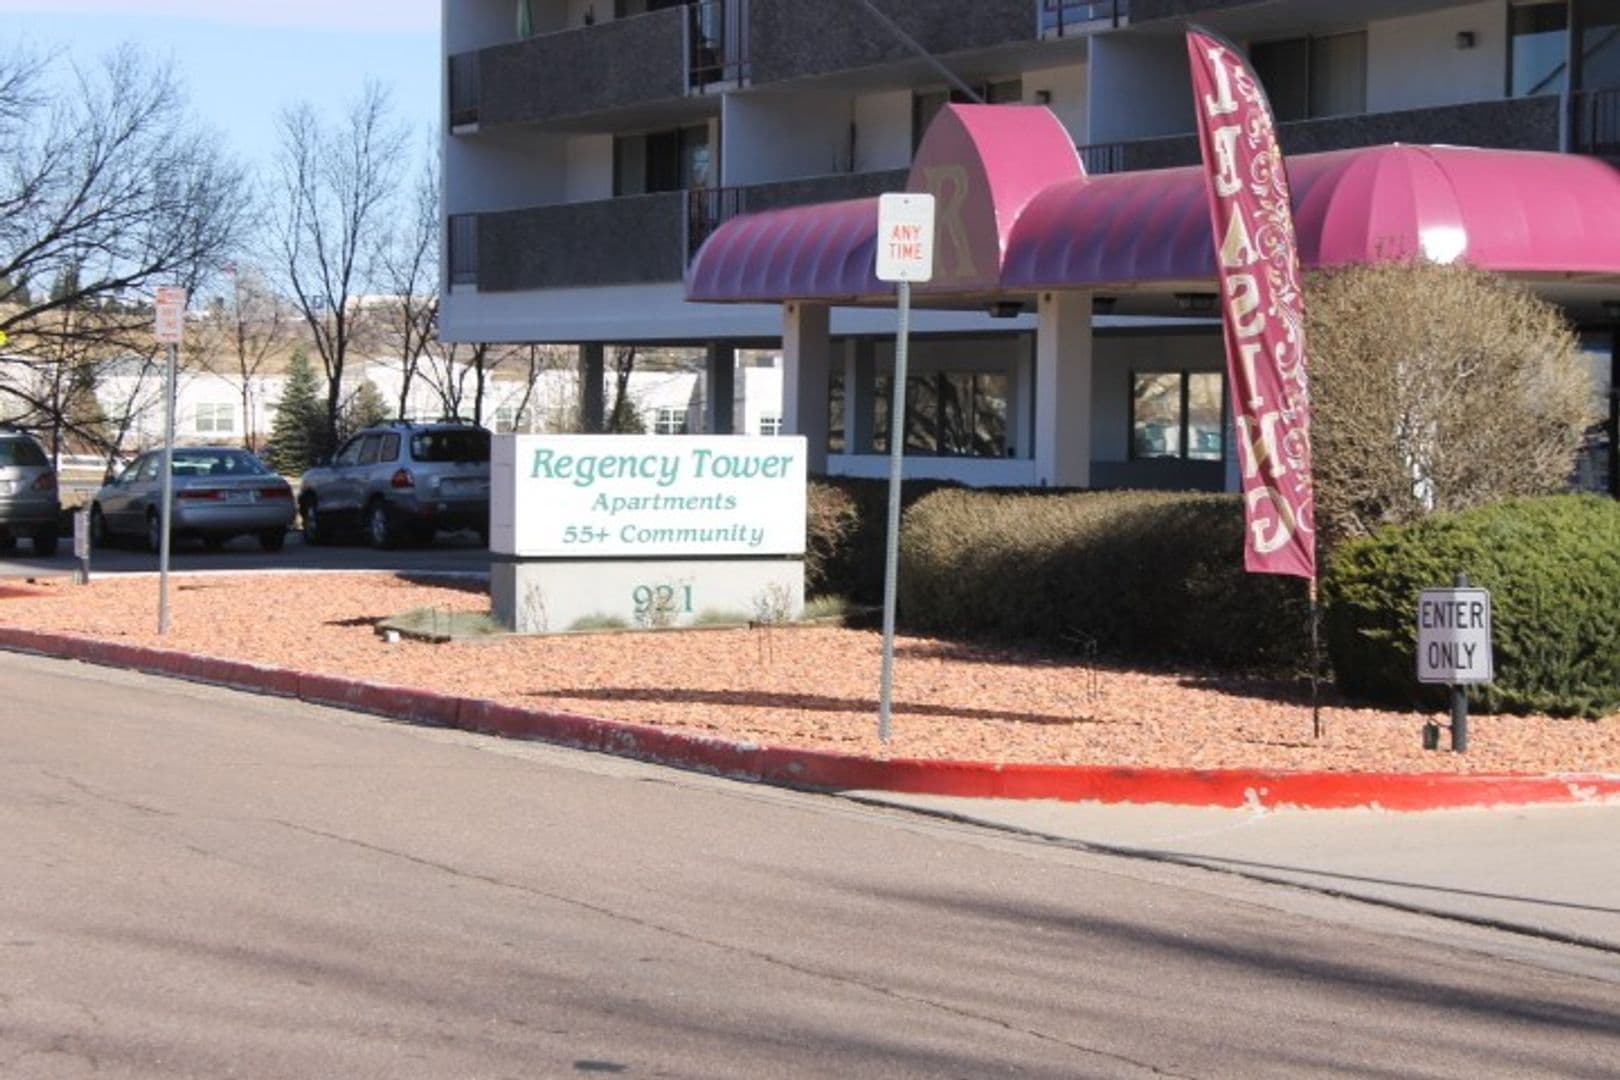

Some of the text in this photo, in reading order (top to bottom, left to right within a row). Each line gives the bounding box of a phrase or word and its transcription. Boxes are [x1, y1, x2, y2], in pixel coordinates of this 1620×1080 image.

[891, 223, 922, 240] ANY
[923, 164, 978, 277] R
[889, 243, 923, 260] TIME
[530, 448, 794, 487] Regency Tower
[591, 492, 737, 515] Apartments
[562, 523, 766, 546] 55+ Community
[632, 584, 694, 614] 921
[1422, 602, 1485, 630] ENTER
[1429, 641, 1477, 670] ONLY
